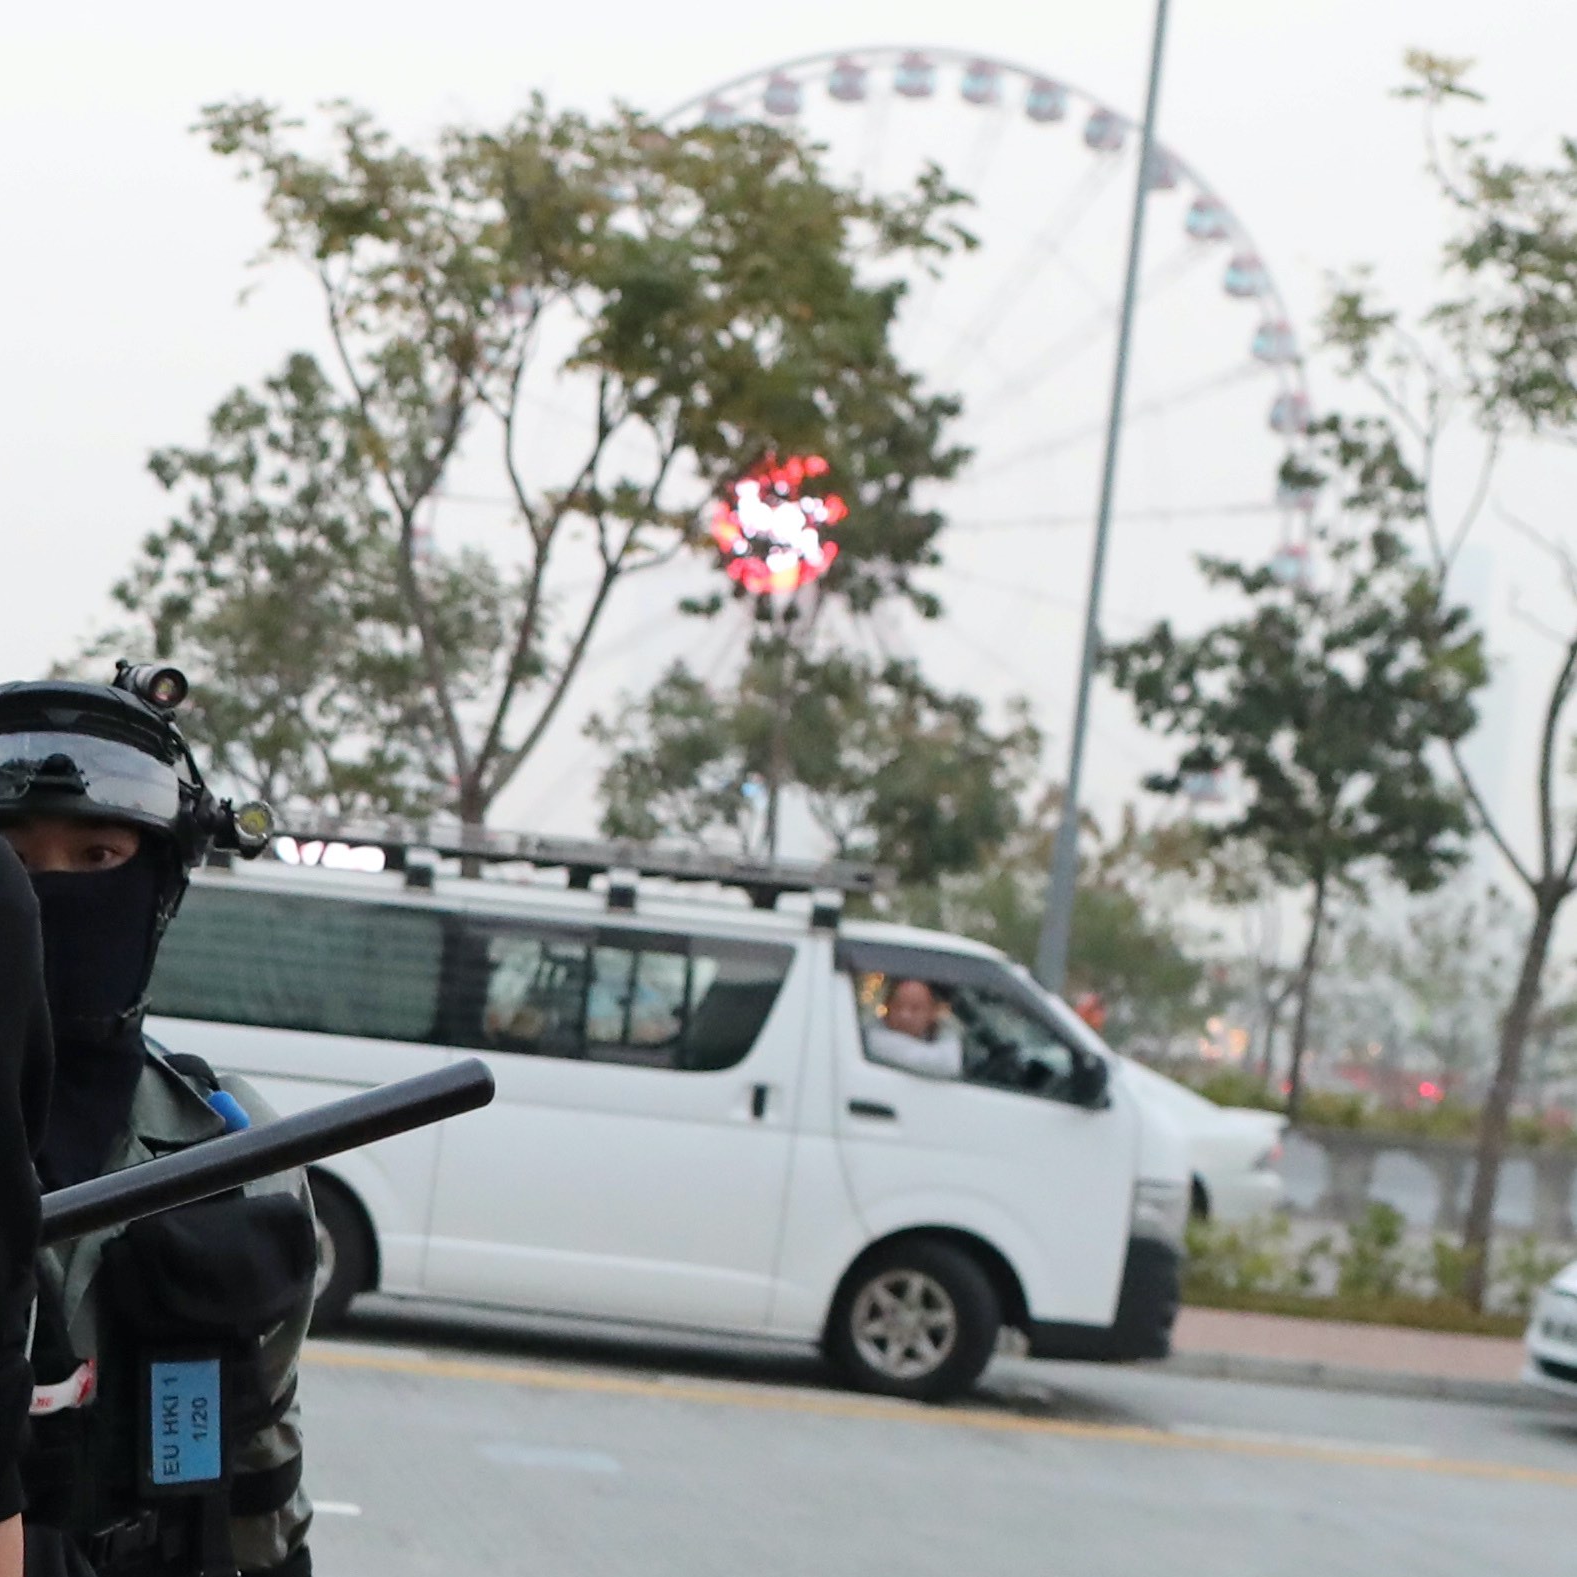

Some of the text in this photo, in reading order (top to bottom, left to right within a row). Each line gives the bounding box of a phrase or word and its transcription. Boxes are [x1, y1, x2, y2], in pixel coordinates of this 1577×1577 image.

[162, 1377, 181, 1477] EU HKI 1
[191, 1397, 208, 1442] 1/20
